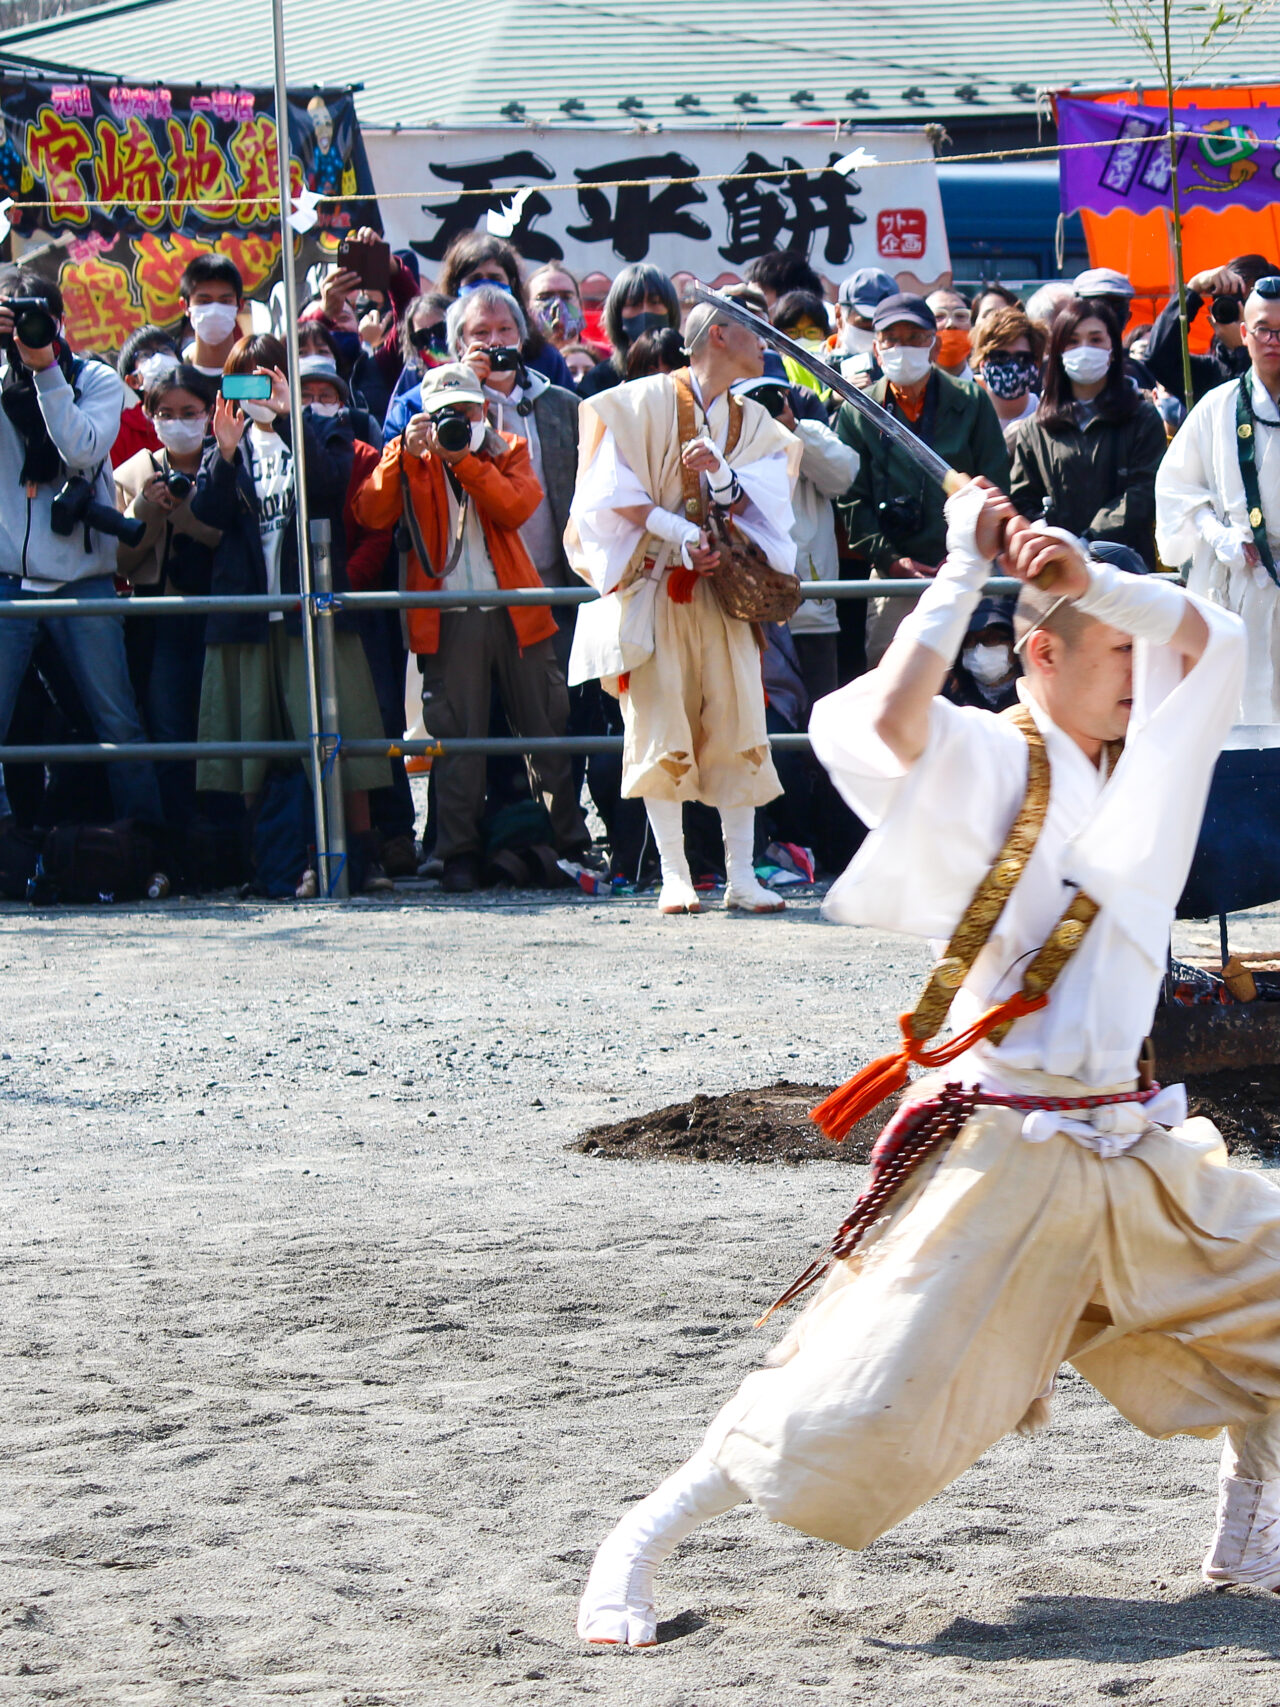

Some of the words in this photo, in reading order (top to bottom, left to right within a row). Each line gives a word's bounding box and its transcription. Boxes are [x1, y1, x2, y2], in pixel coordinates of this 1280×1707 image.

[26, 106, 303, 231] 宮崎地鶏
[409, 150, 867, 265] 五平餅
[881, 232, 922, 253] 企画
